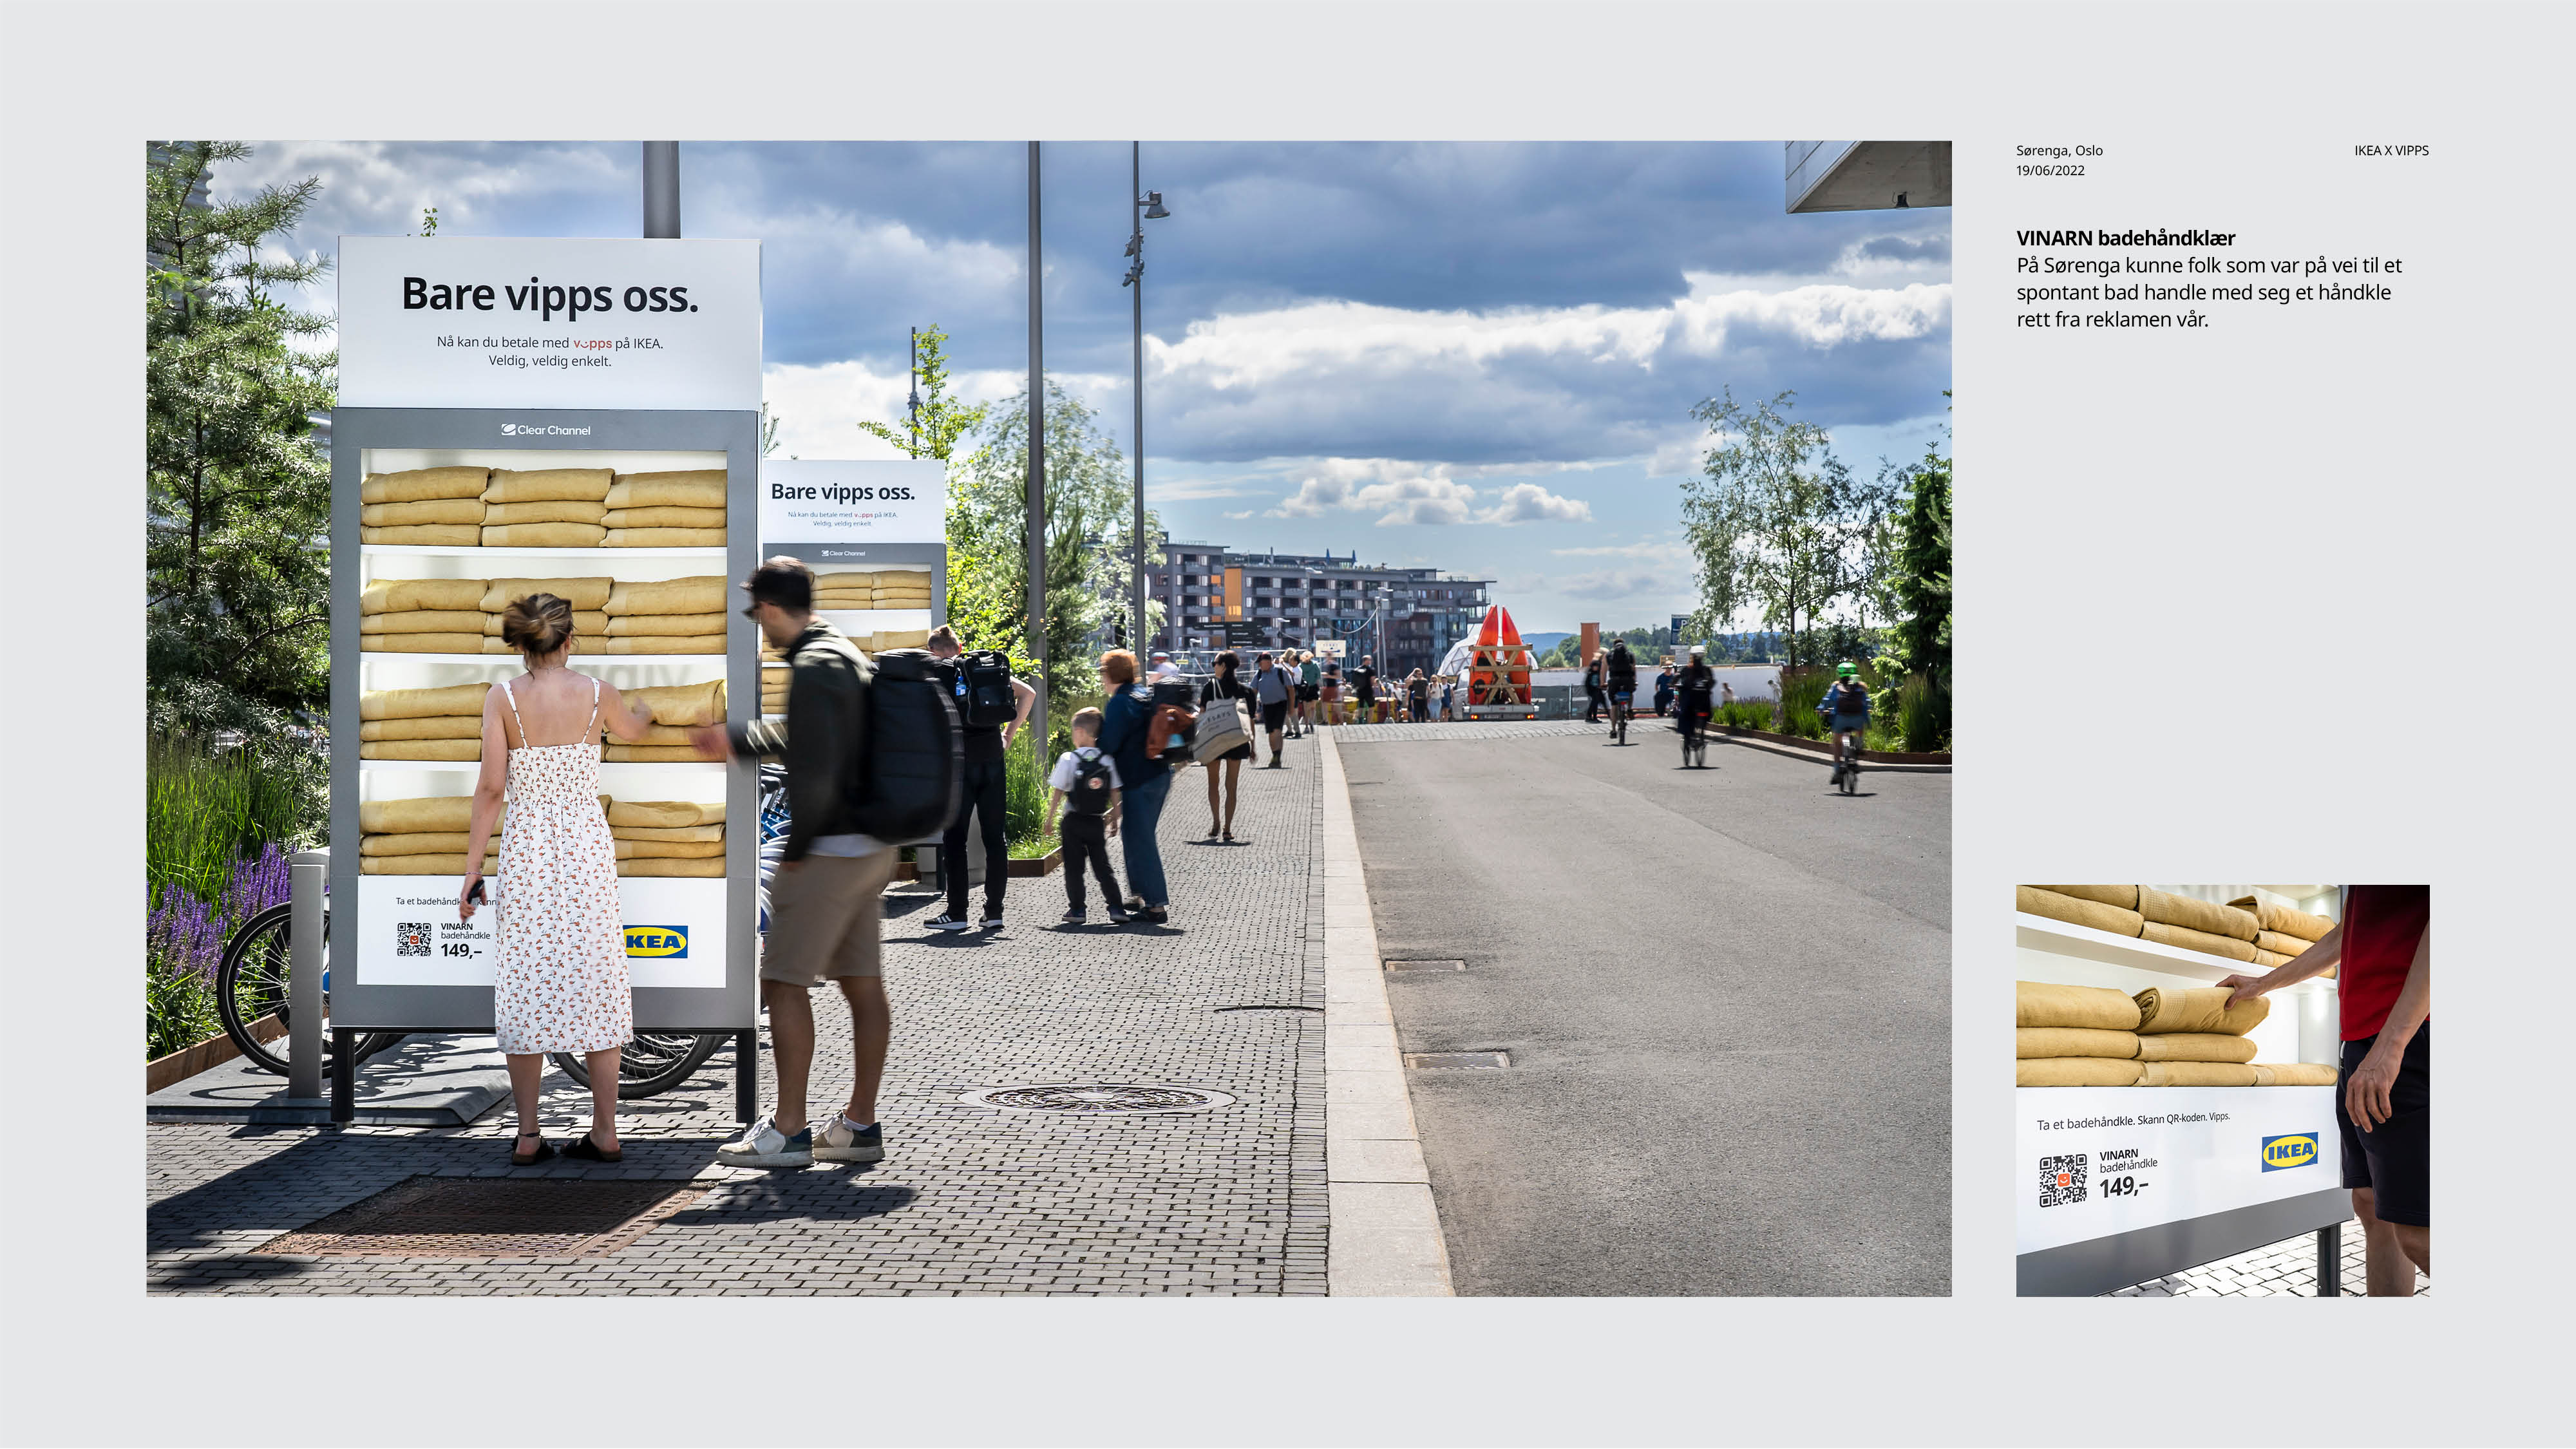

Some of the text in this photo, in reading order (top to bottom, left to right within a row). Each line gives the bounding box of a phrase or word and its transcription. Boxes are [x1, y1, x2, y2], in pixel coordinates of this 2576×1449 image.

[403, 276, 698, 322] Bare vipps oss.
[437, 335, 454, 348] Nå
[458, 336, 479, 348] kan
[482, 336, 498, 348] du
[502, 336, 539, 348] betale
[542, 337, 569, 349] med
[615, 336, 630, 352] på
[634, 338, 663, 350] IKEA.
[488, 354, 612, 370] Veldig, veldig enkelt.
[517, 424, 591, 436] Clear Channel
[772, 482, 915, 505] Bare vipps oss.
[417, 897, 461, 905] badehåndk
[440, 931, 491, 940] badehåndkle
[625, 934, 681, 949] KEA
[2037, 1112, 2230, 1130] Ta et badehåndkle. Skann QR-koden. Vipps.
[2099, 1149, 2139, 1160] VINARN
[2268, 1142, 2314, 1160] IKEA
[2099, 1158, 2158, 1173] badehåndkle
